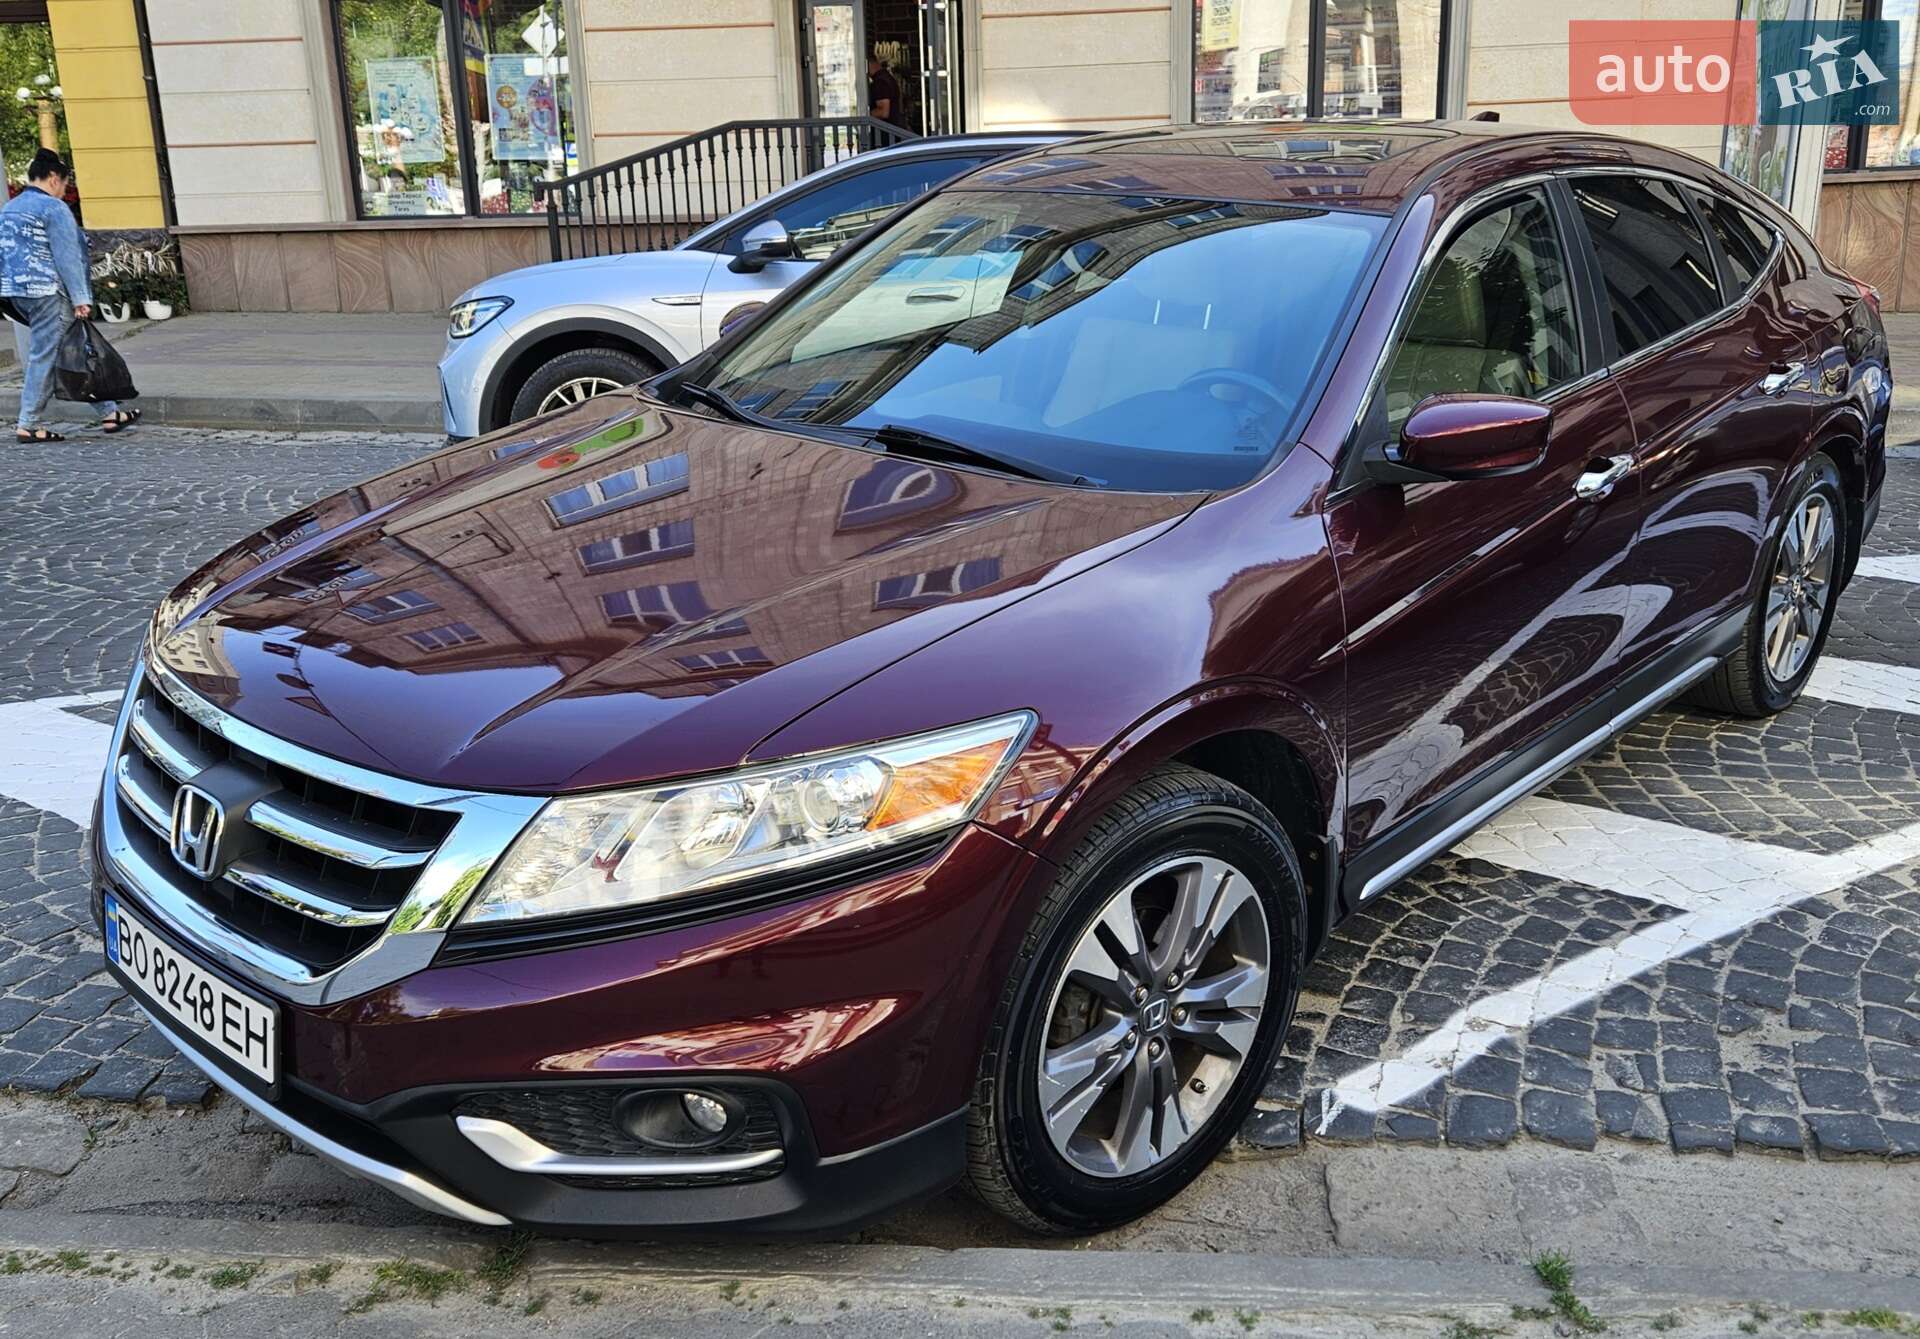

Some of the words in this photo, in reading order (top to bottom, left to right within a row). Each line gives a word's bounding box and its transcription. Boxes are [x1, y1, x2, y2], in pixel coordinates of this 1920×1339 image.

[119, 914, 148, 980] BO
[153, 947, 215, 1032] 8248
[221, 992, 269, 1069] EH
